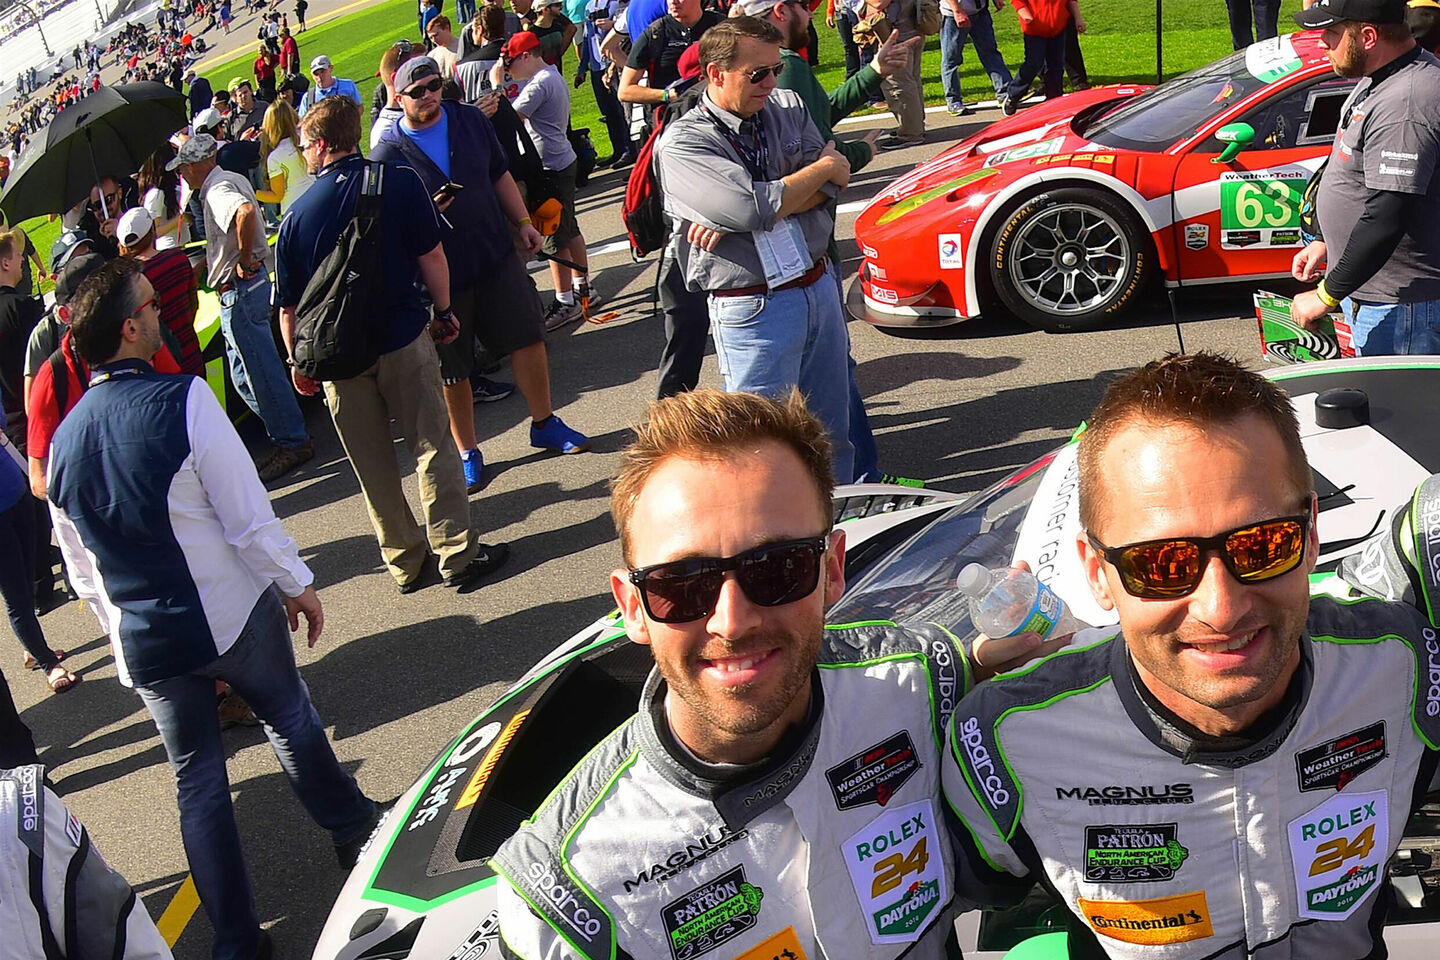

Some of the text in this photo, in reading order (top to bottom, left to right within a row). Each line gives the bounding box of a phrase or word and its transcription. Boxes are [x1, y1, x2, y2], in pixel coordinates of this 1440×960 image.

[1225, 171, 1303, 180] WeatherTech
[1235, 181, 1292, 228] 63
[995, 205, 1032, 269] CONTINENTAL
[1106, 252, 1143, 313] CONTINENTAL
[932, 640, 956, 730] sparco
[836, 748, 911, 793] WeatherTech
[960, 717, 1010, 810] sparco
[1304, 739, 1384, 775] WeatherTech
[1056, 784, 1193, 800] MAGNUS
[856, 813, 926, 862] ROLEX
[1097, 831, 1165, 849] PATRÓN
[1302, 801, 1377, 842] ROLEX
[624, 825, 733, 891] MAGNUS
[871, 836, 930, 899] 24
[1308, 824, 1376, 877] 24
[523, 862, 601, 942] sparco
[674, 880, 740, 925] PATRÓN
[880, 886, 938, 929] DAYTONA
[1311, 872, 1377, 905] DAYTONA
[1091, 913, 1184, 931] Continental
